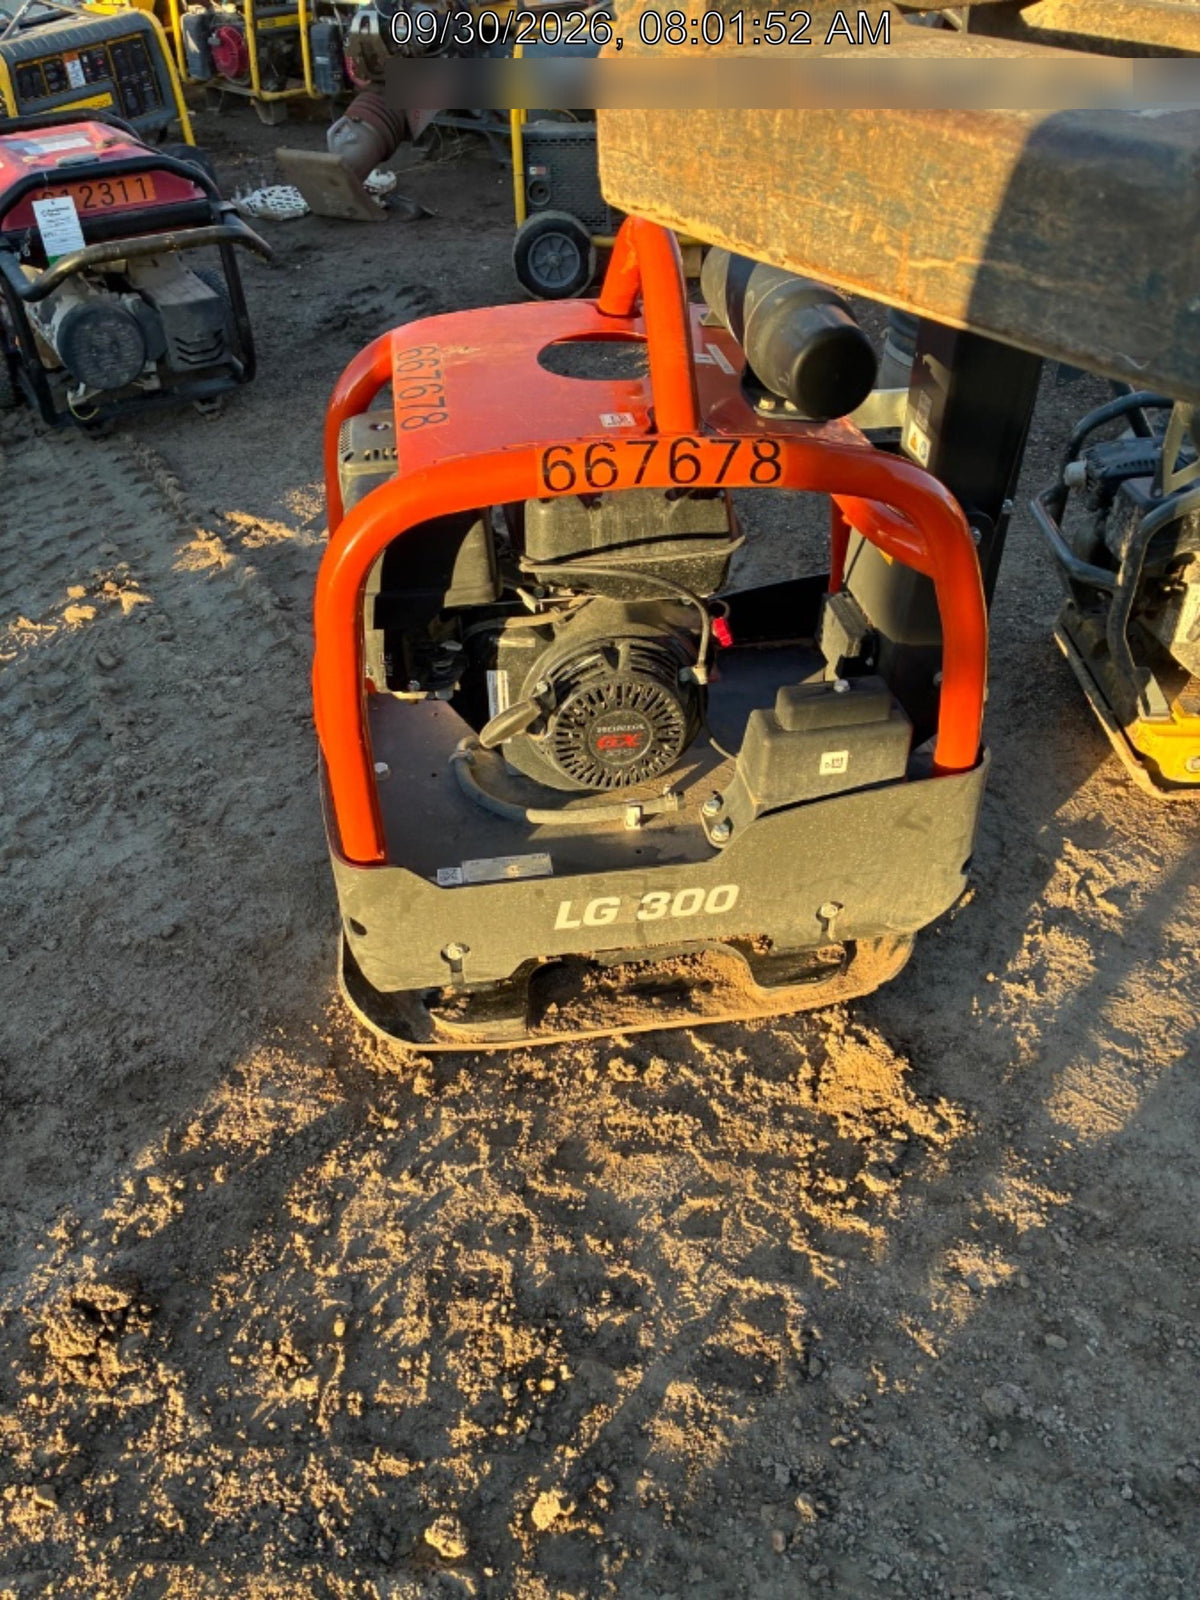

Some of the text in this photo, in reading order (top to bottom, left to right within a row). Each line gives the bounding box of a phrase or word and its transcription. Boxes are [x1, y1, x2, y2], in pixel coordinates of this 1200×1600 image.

[41, 177, 148, 209] 2311
[397, 346, 448, 430] 667678
[541, 437, 782, 492] 667678
[597, 723, 645, 733] HONDA
[554, 884, 740, 930] LG 300
